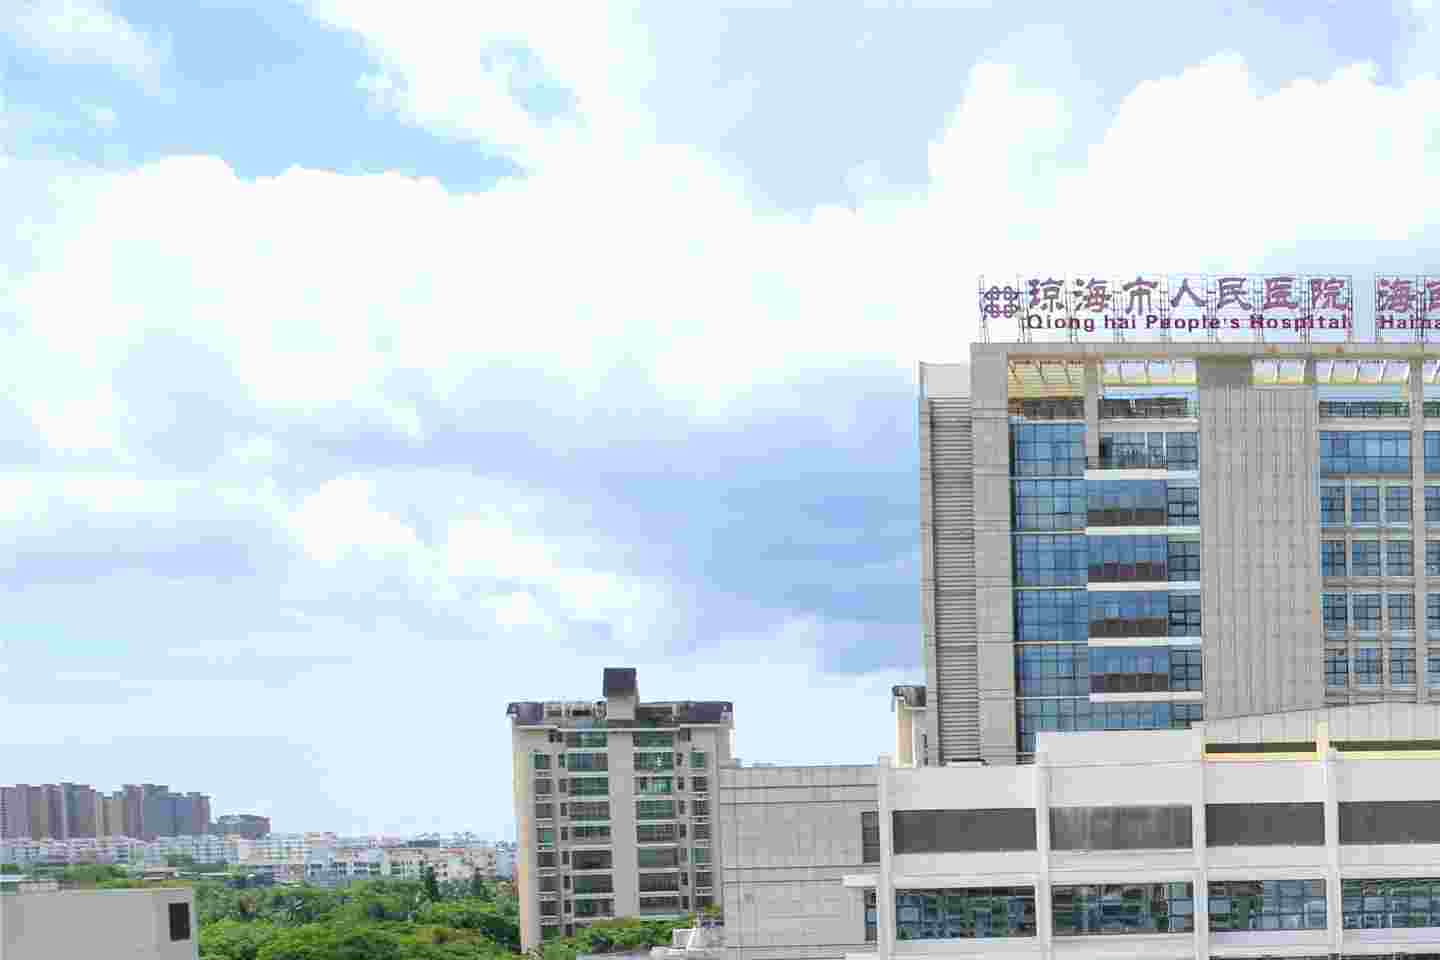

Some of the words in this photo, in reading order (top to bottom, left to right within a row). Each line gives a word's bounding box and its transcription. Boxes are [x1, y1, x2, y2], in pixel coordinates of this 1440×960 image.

[1029, 277, 1348, 314] 琼海市人民医院
[1146, 314, 1241, 332] People's
[1251, 314, 1347, 332] Hospital
